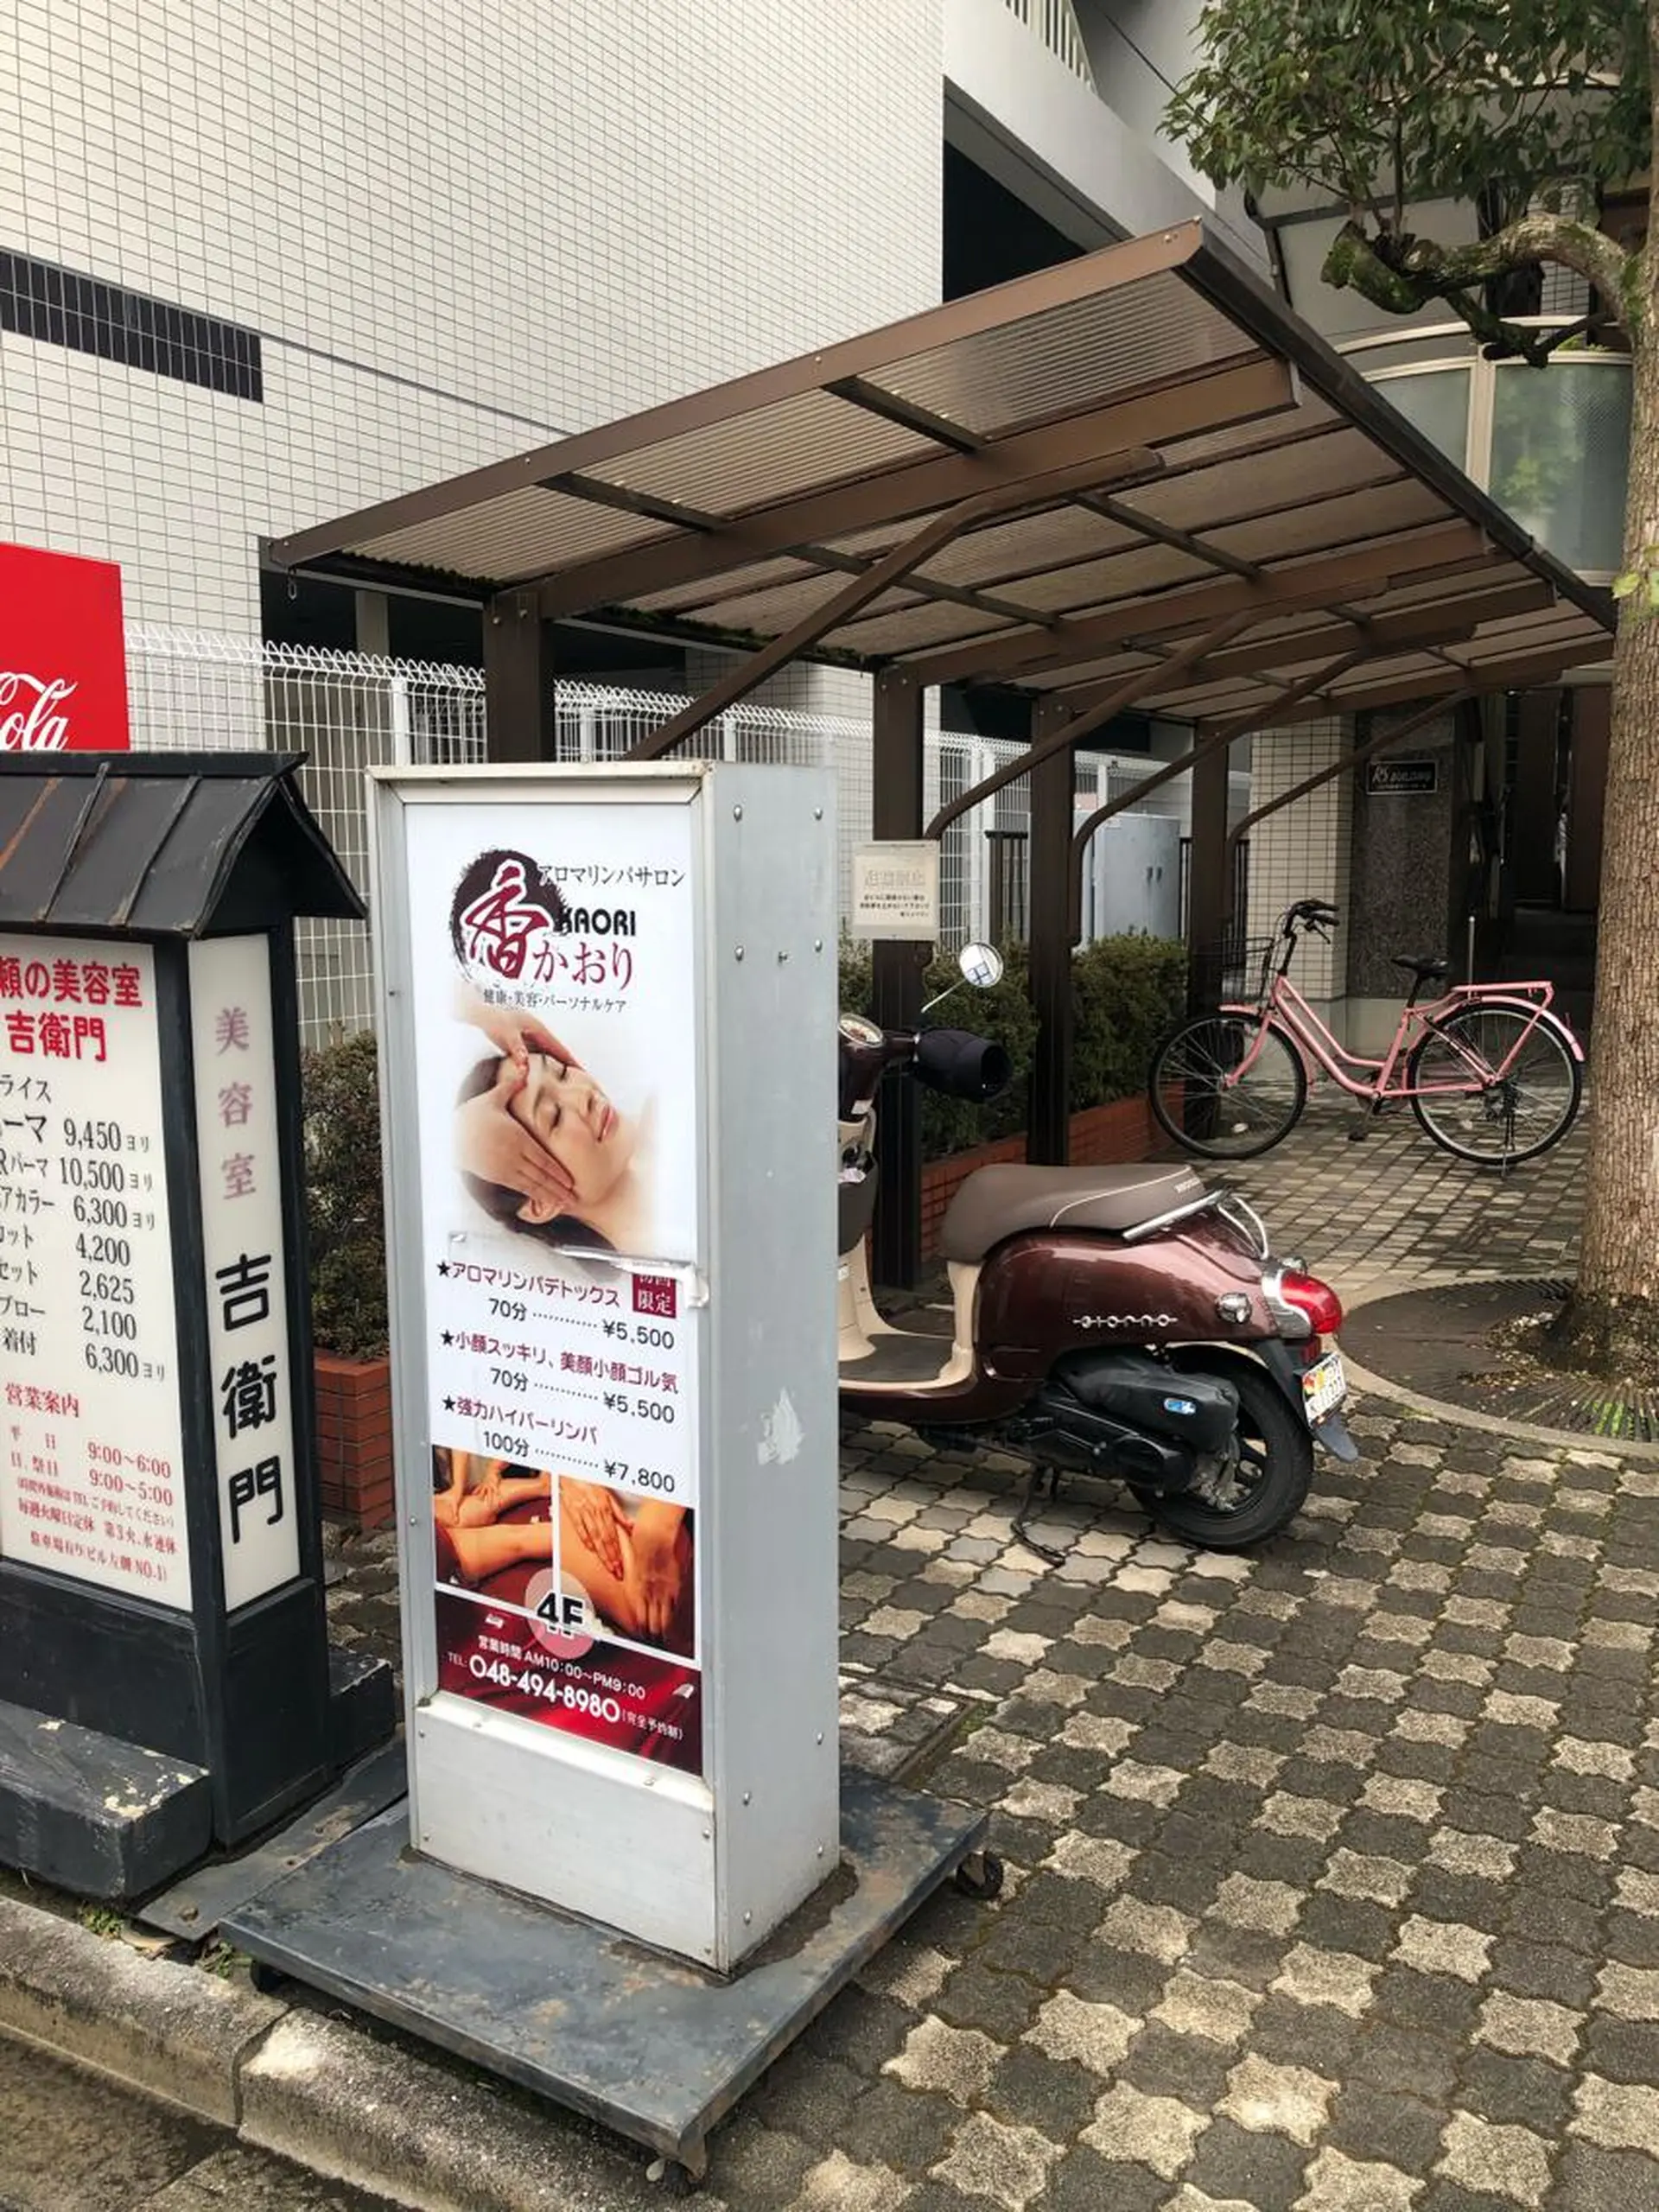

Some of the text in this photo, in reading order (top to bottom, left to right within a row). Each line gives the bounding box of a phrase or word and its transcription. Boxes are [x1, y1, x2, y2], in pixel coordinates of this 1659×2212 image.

[0, 672, 79, 751] ola
[538, 864, 686, 887] アロマリンパサロン
[554, 906, 636, 937] KAORI
[532, 939, 632, 991] かおり
[483, 988, 627, 1013] 健康・美容・パーソナルケア
[5, 1009, 106, 1062] 吉衛門
[215, 1006, 257, 1201] 美容室
[0, 1113, 48, 1144] ーマ
[75, 1232, 131, 1268] 4,200
[79, 1269, 135, 1305] 2,625
[637, 1289, 673, 1316] 限定
[82, 1306, 137, 1341] 2,100
[488, 1297, 528, 1322] 70分
[489, 1367, 529, 1392] 70分
[5, 1382, 79, 1419] 営業案内
[214, 1253, 283, 1544] 吉衛門
[482, 1430, 530, 1458] 100分
[536, 1592, 584, 1637] 4F
[478, 1634, 522, 1660] 営業時間
[469, 1654, 620, 1724] 048-494-8980
